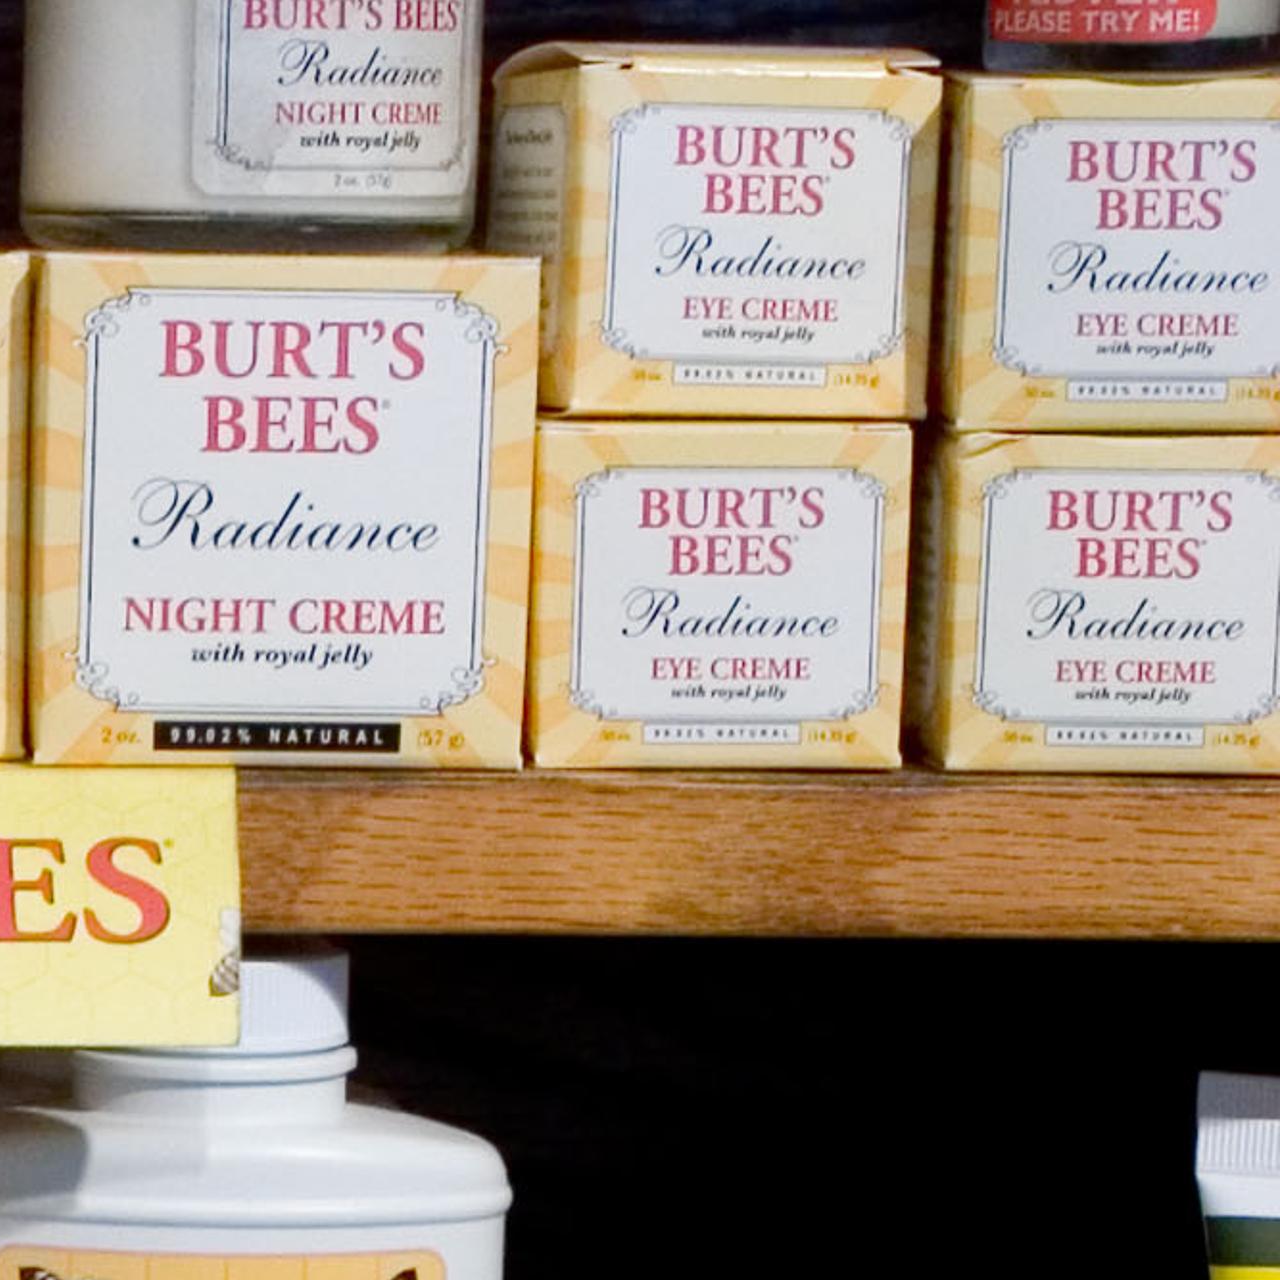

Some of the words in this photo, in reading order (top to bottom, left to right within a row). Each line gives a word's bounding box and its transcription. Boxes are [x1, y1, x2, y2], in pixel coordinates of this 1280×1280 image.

[993, 10, 1074, 33] PLEASE
[1082, 10, 1143, 32] TRY
[1149, 10, 1200, 32] ME!
[674, 125, 856, 169] BURT'S
[702, 175, 825, 217] BEES
[654, 225, 866, 280] Radiance
[682, 298, 735, 322] EYE
[741, 297, 838, 322] CREME
[158, 319, 426, 380] BURT'S
[200, 395, 381, 454] BEES
[130, 478, 440, 552] Radiance
[123, 598, 276, 634] NIGHT
[290, 599, 446, 635] CREME
[191, 643, 245, 664] with
[253, 645, 318, 669] royal
[319, 643, 373, 668] jelly
[269, 727, 385, 745] NATURAL
